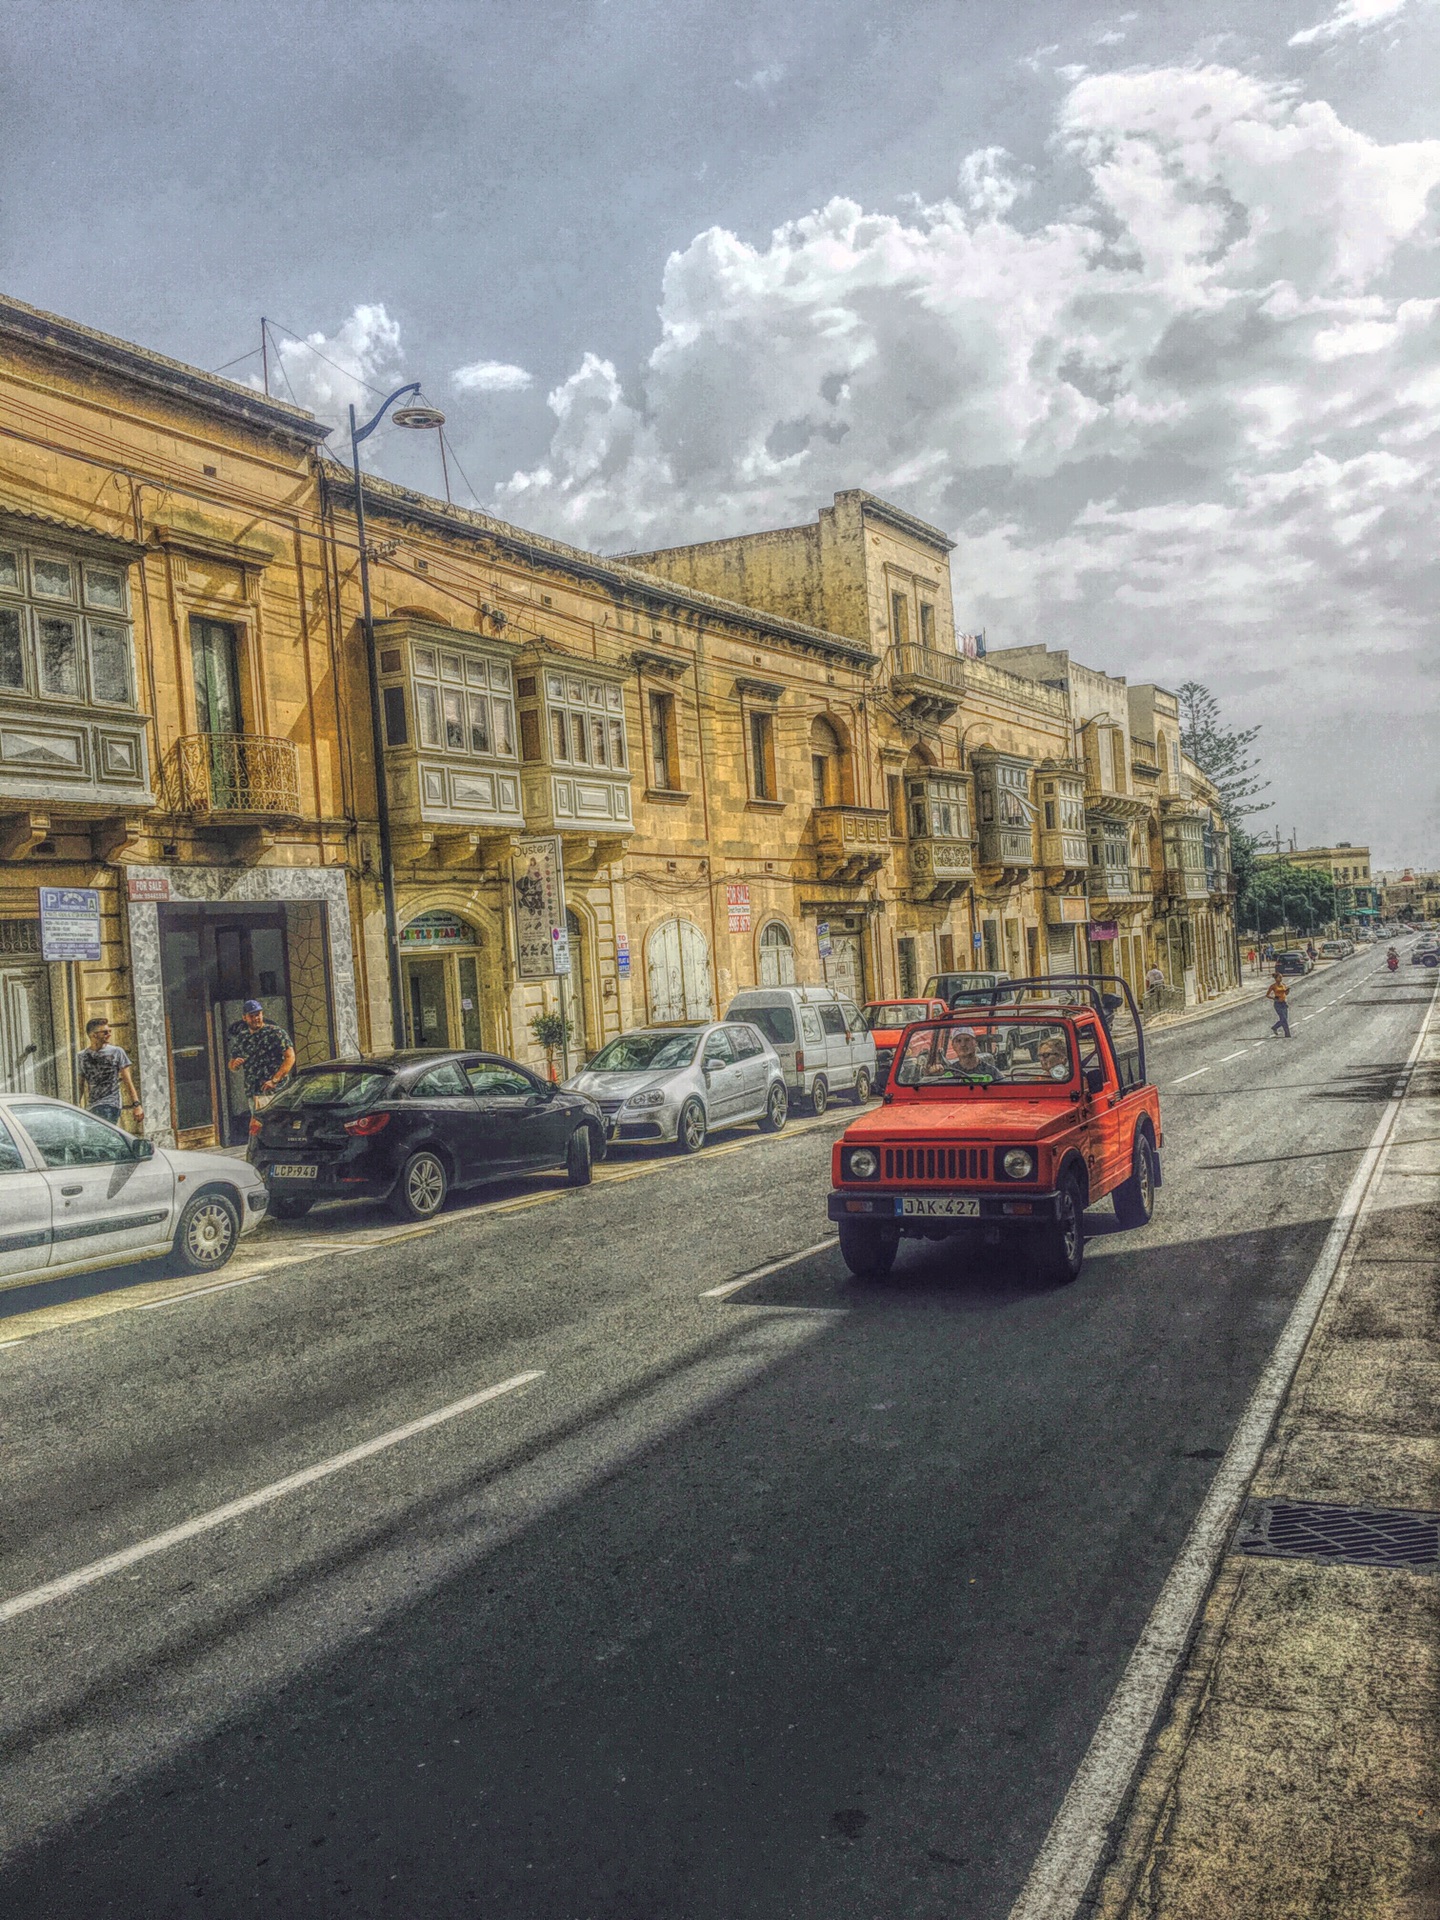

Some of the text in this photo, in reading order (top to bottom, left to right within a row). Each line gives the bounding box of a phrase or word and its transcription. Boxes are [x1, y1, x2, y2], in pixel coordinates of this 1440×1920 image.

[136, 881, 162, 891] FOR SALE
[47, 893, 57, 907] P
[727, 885, 750, 903] FOR SALE
[88, 899, 96, 910] A
[400, 928, 460, 940] LITTLE STARS
